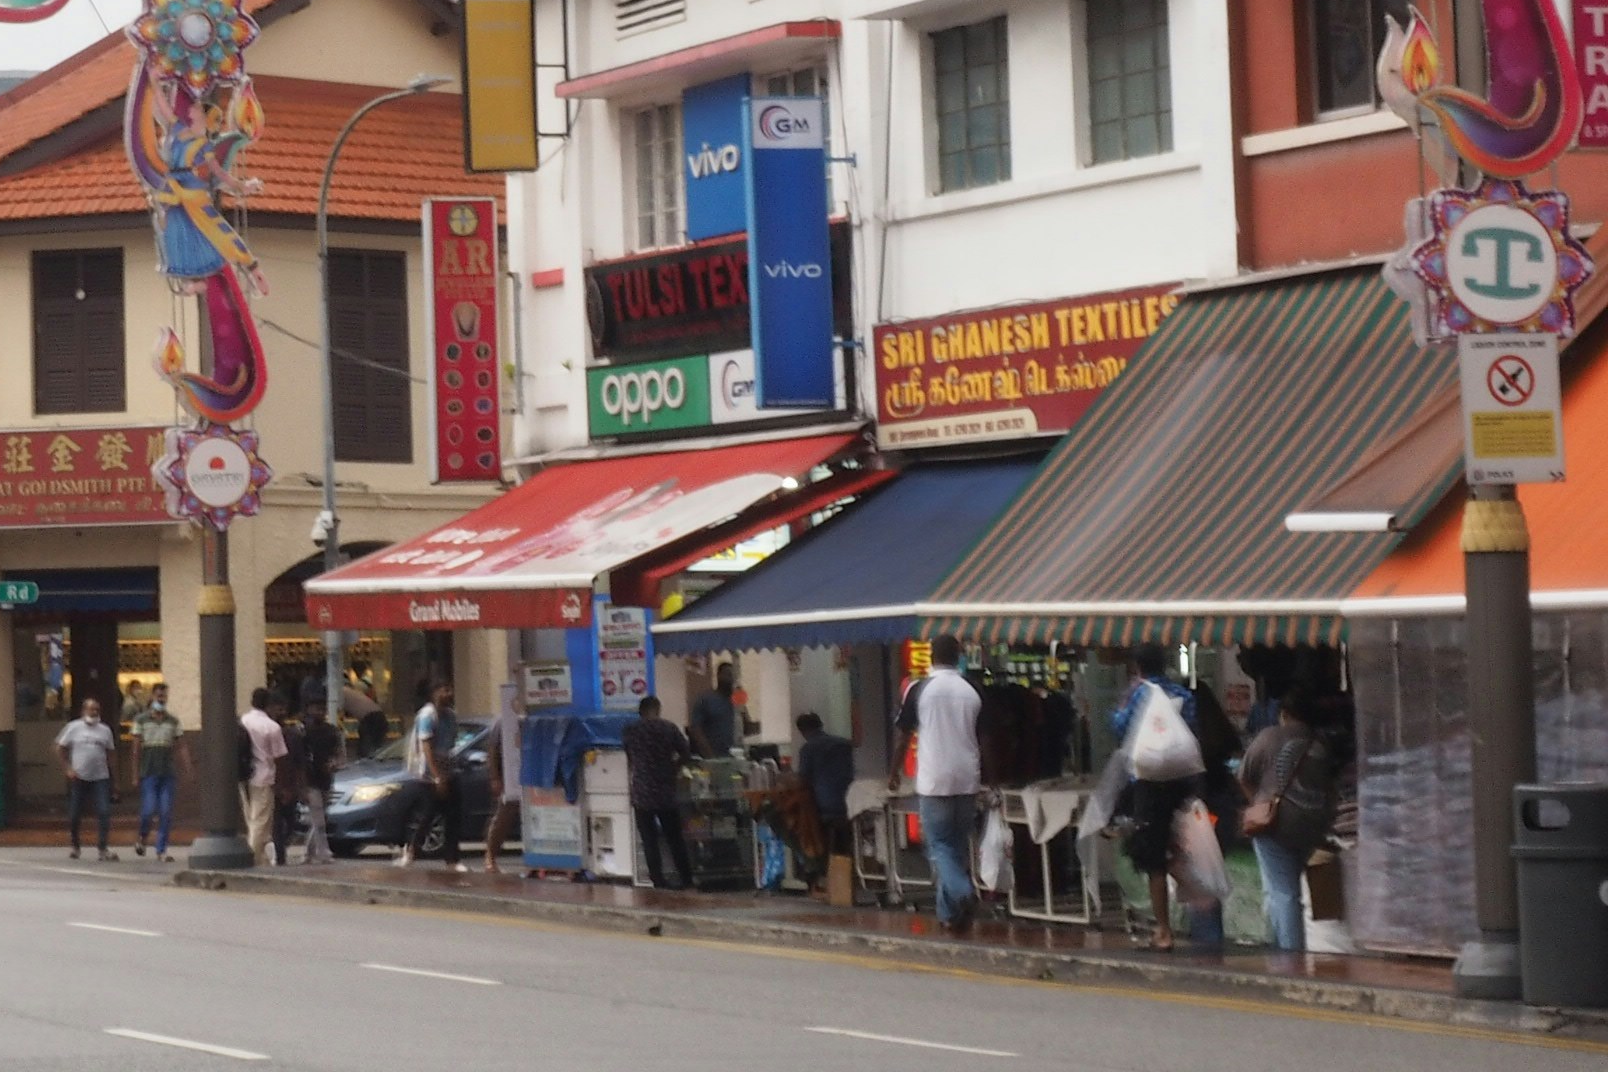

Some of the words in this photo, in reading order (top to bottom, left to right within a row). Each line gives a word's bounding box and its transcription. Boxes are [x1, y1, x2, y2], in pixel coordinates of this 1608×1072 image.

[688, 143, 740, 179] vivo
[440, 239, 492, 276] AR
[763, 260, 823, 279] vivo
[607, 263, 687, 322] TULSI
[881, 329, 926, 370] SRI
[931, 311, 1051, 364] GHANESH
[602, 368, 685, 426] oppo
[18, 478, 112, 496] GOLDSMITH
[117, 477, 146, 494] PTE
[6, 583, 29, 601] Rd
[409, 599, 441, 623] Grand
